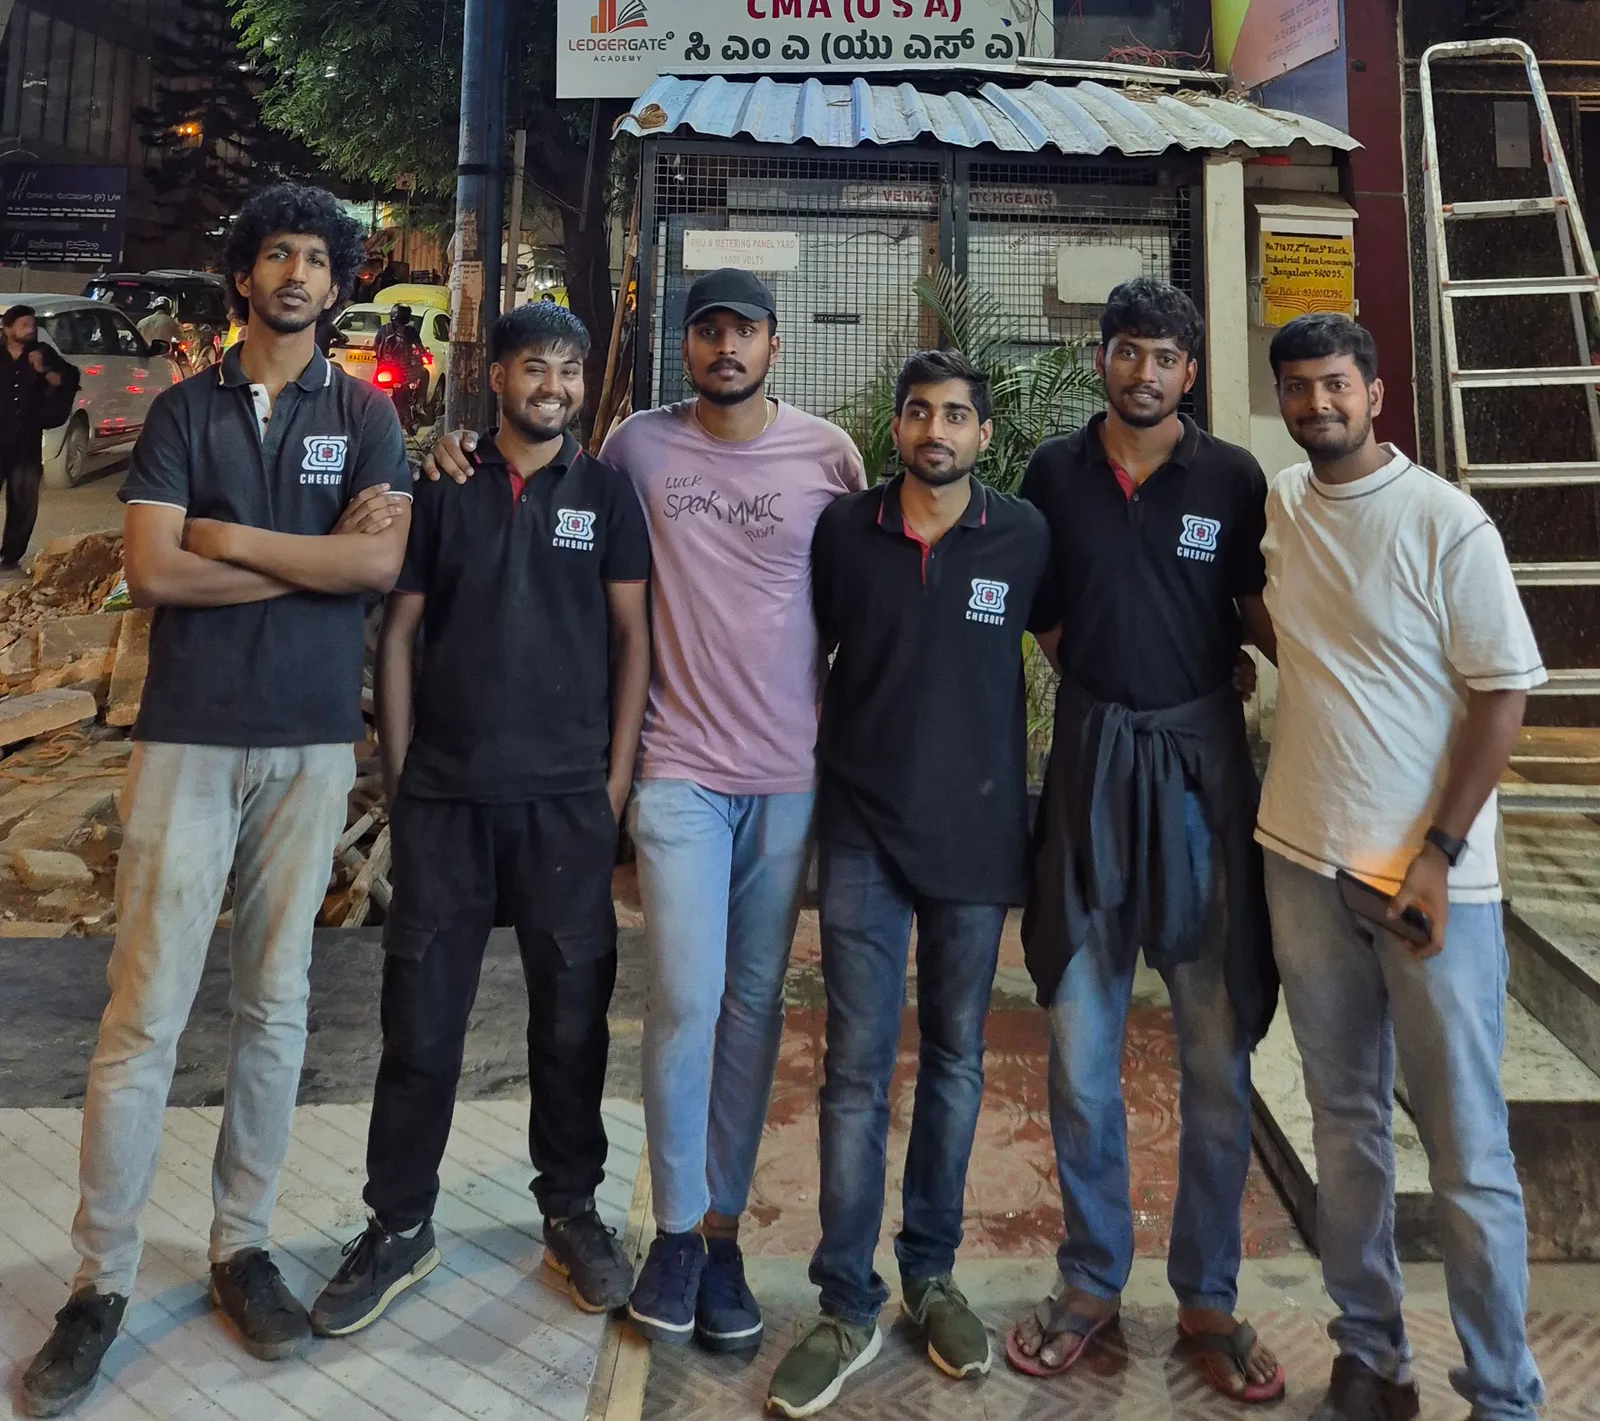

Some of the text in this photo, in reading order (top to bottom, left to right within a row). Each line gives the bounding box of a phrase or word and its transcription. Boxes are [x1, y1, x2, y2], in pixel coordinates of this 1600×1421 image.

[684, 31, 711, 61] ಸಿ
[721, 35, 771, 60] ಎಂ
[781, 34, 810, 60] ಎ
[903, 28, 975, 59] ಎಸ್
[715, 239, 751, 248] METERING
[752, 239, 774, 248] PANEL
[776, 240, 795, 248] YARD
[742, 255, 765, 265] VOLTS
[665, 475, 702, 489] LUCK
